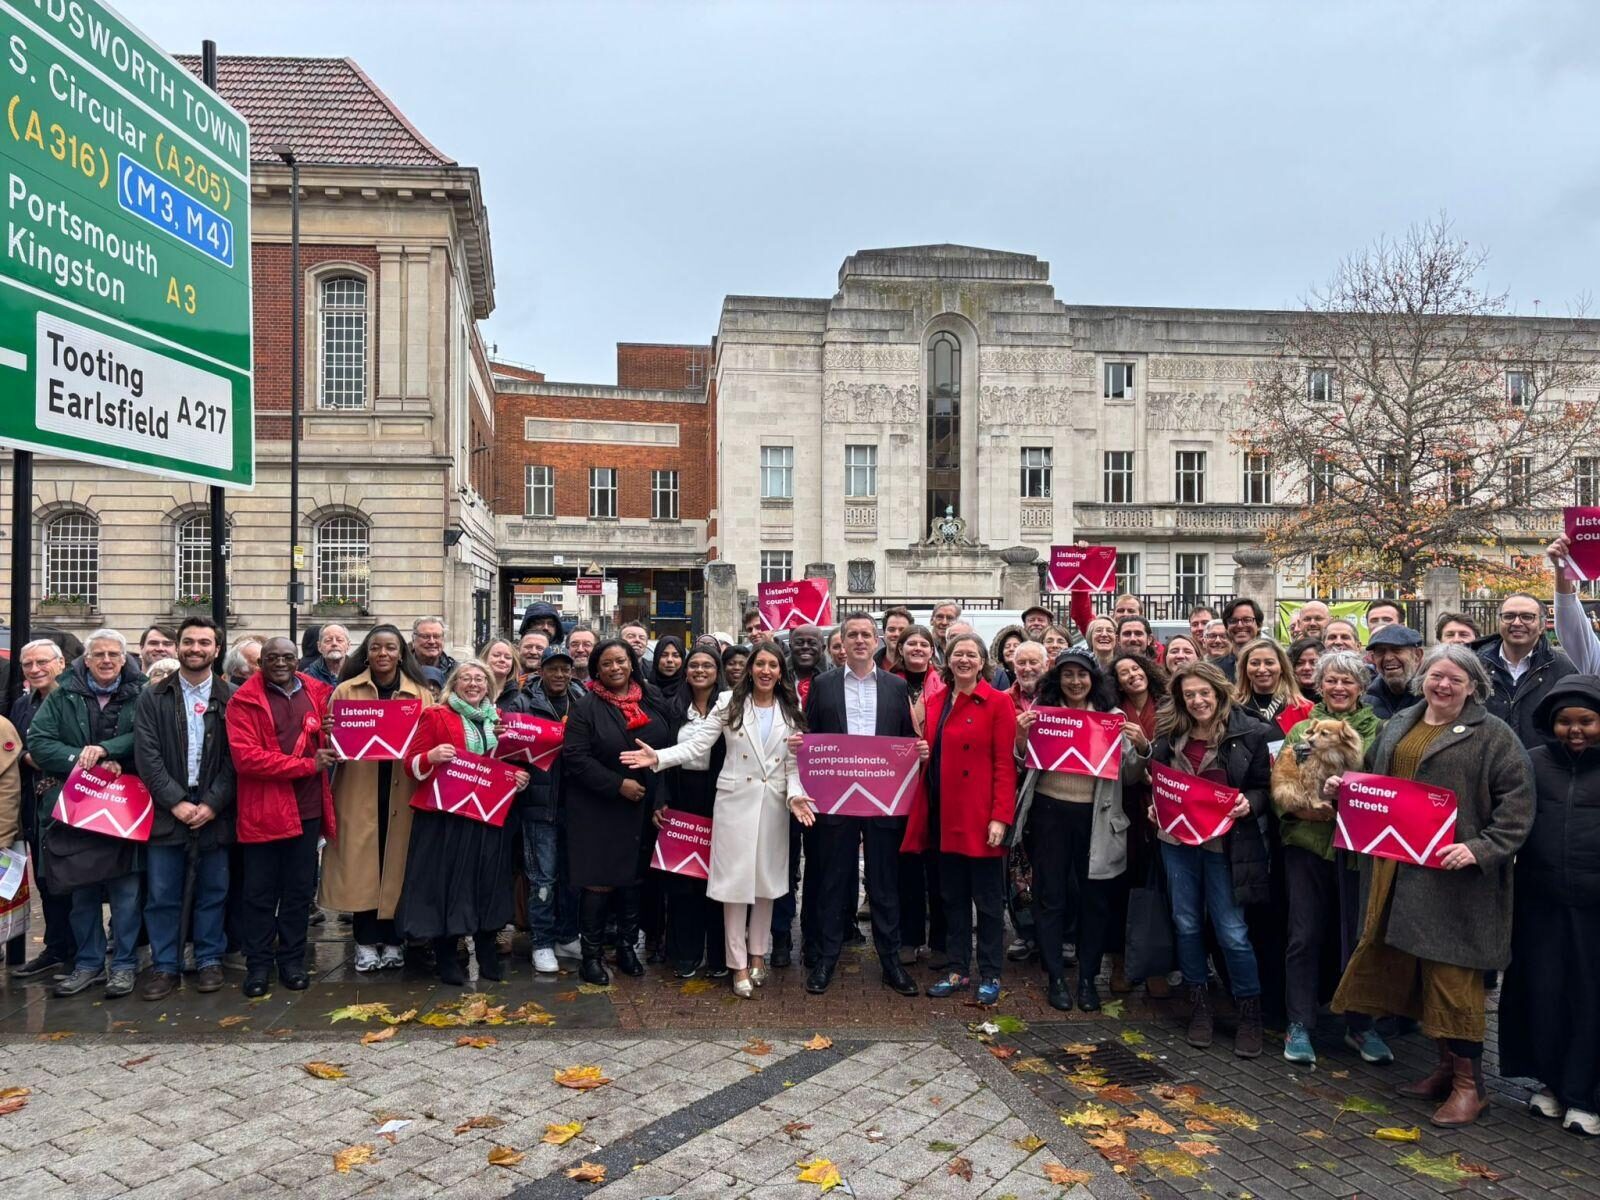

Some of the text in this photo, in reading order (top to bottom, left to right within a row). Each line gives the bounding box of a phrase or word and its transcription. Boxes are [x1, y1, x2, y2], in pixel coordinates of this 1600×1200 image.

[34, 0, 241, 158] DSWORTH TOWN
[9, 35, 147, 152] S. Circular
[123, 166, 229, 258] (M3, M4)
[9, 173, 158, 278] Portsmouth
[8, 221, 125, 304] Kingston
[166, 276, 197, 315] A3
[46, 330, 144, 398] Tooting
[48, 378, 169, 440] Earlsfield
[177, 396, 227, 434] A217
[1056, 551, 1087, 560] Listening
[765, 586, 799, 595] Listening
[765, 597, 794, 605] council
[341, 707, 384, 718] Listening
[1039, 714, 1083, 728] Listening
[340, 719, 376, 728] council
[508, 720, 542, 734] Listening
[507, 732, 536, 742] council
[1038, 728, 1074, 738] council
[809, 744, 840, 753] Fairer,
[451, 756, 476, 770] Same
[476, 763, 492, 775] low
[808, 755, 889, 767] compassionate,
[80, 770, 107, 787] Same
[446, 769, 492, 788] council tax
[808, 767, 896, 777] more sustainable
[1157, 772, 1190, 792] Cleaner
[1349, 782, 1398, 799] Cleaner
[74, 783, 128, 804] council tax
[1156, 786, 1182, 804] streets
[1349, 799, 1389, 814] streets
[670, 818, 695, 830] Same
[666, 830, 699, 844] council
